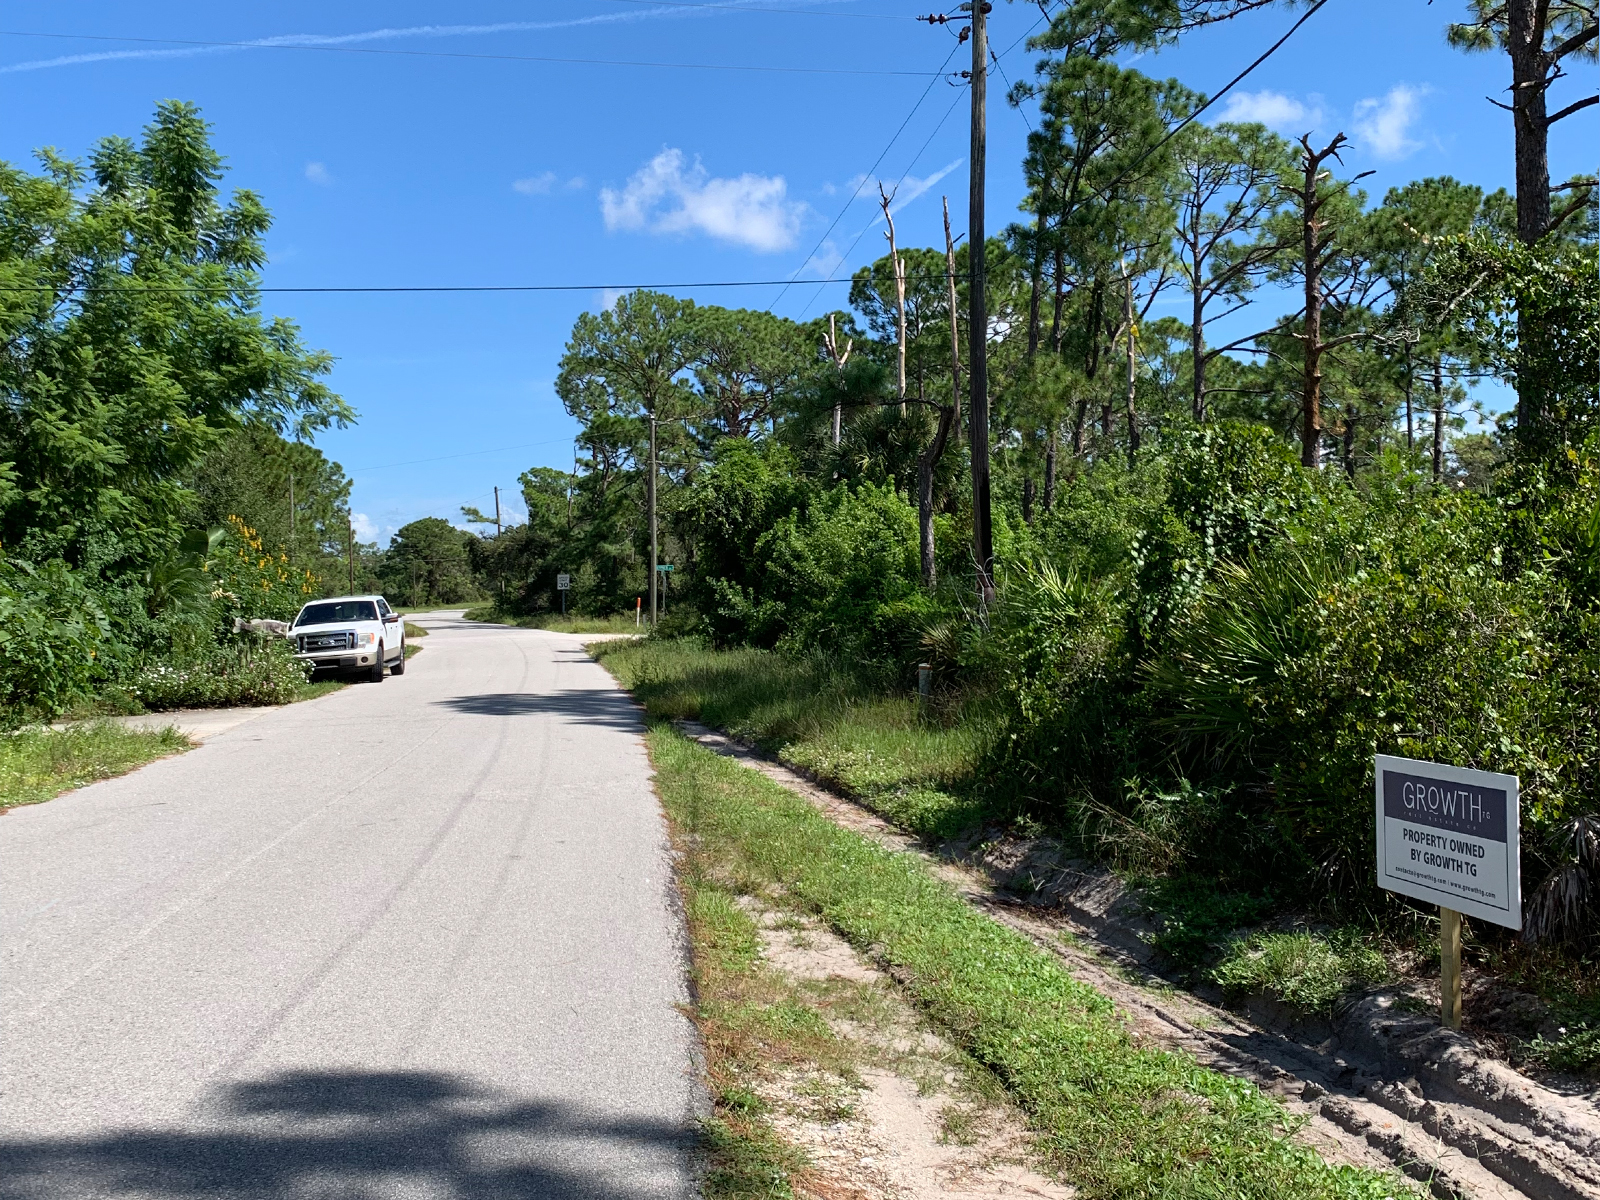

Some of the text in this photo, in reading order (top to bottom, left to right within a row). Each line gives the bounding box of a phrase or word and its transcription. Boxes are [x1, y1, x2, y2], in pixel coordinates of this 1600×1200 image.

[1402, 781, 1491, 823] GROWTH TG
[1403, 828, 1485, 859] PROPERTY OWNED
[1410, 848, 1477, 877] BY GROWTH TG
[1450, 881, 1496, 899] www.growthtg.com
